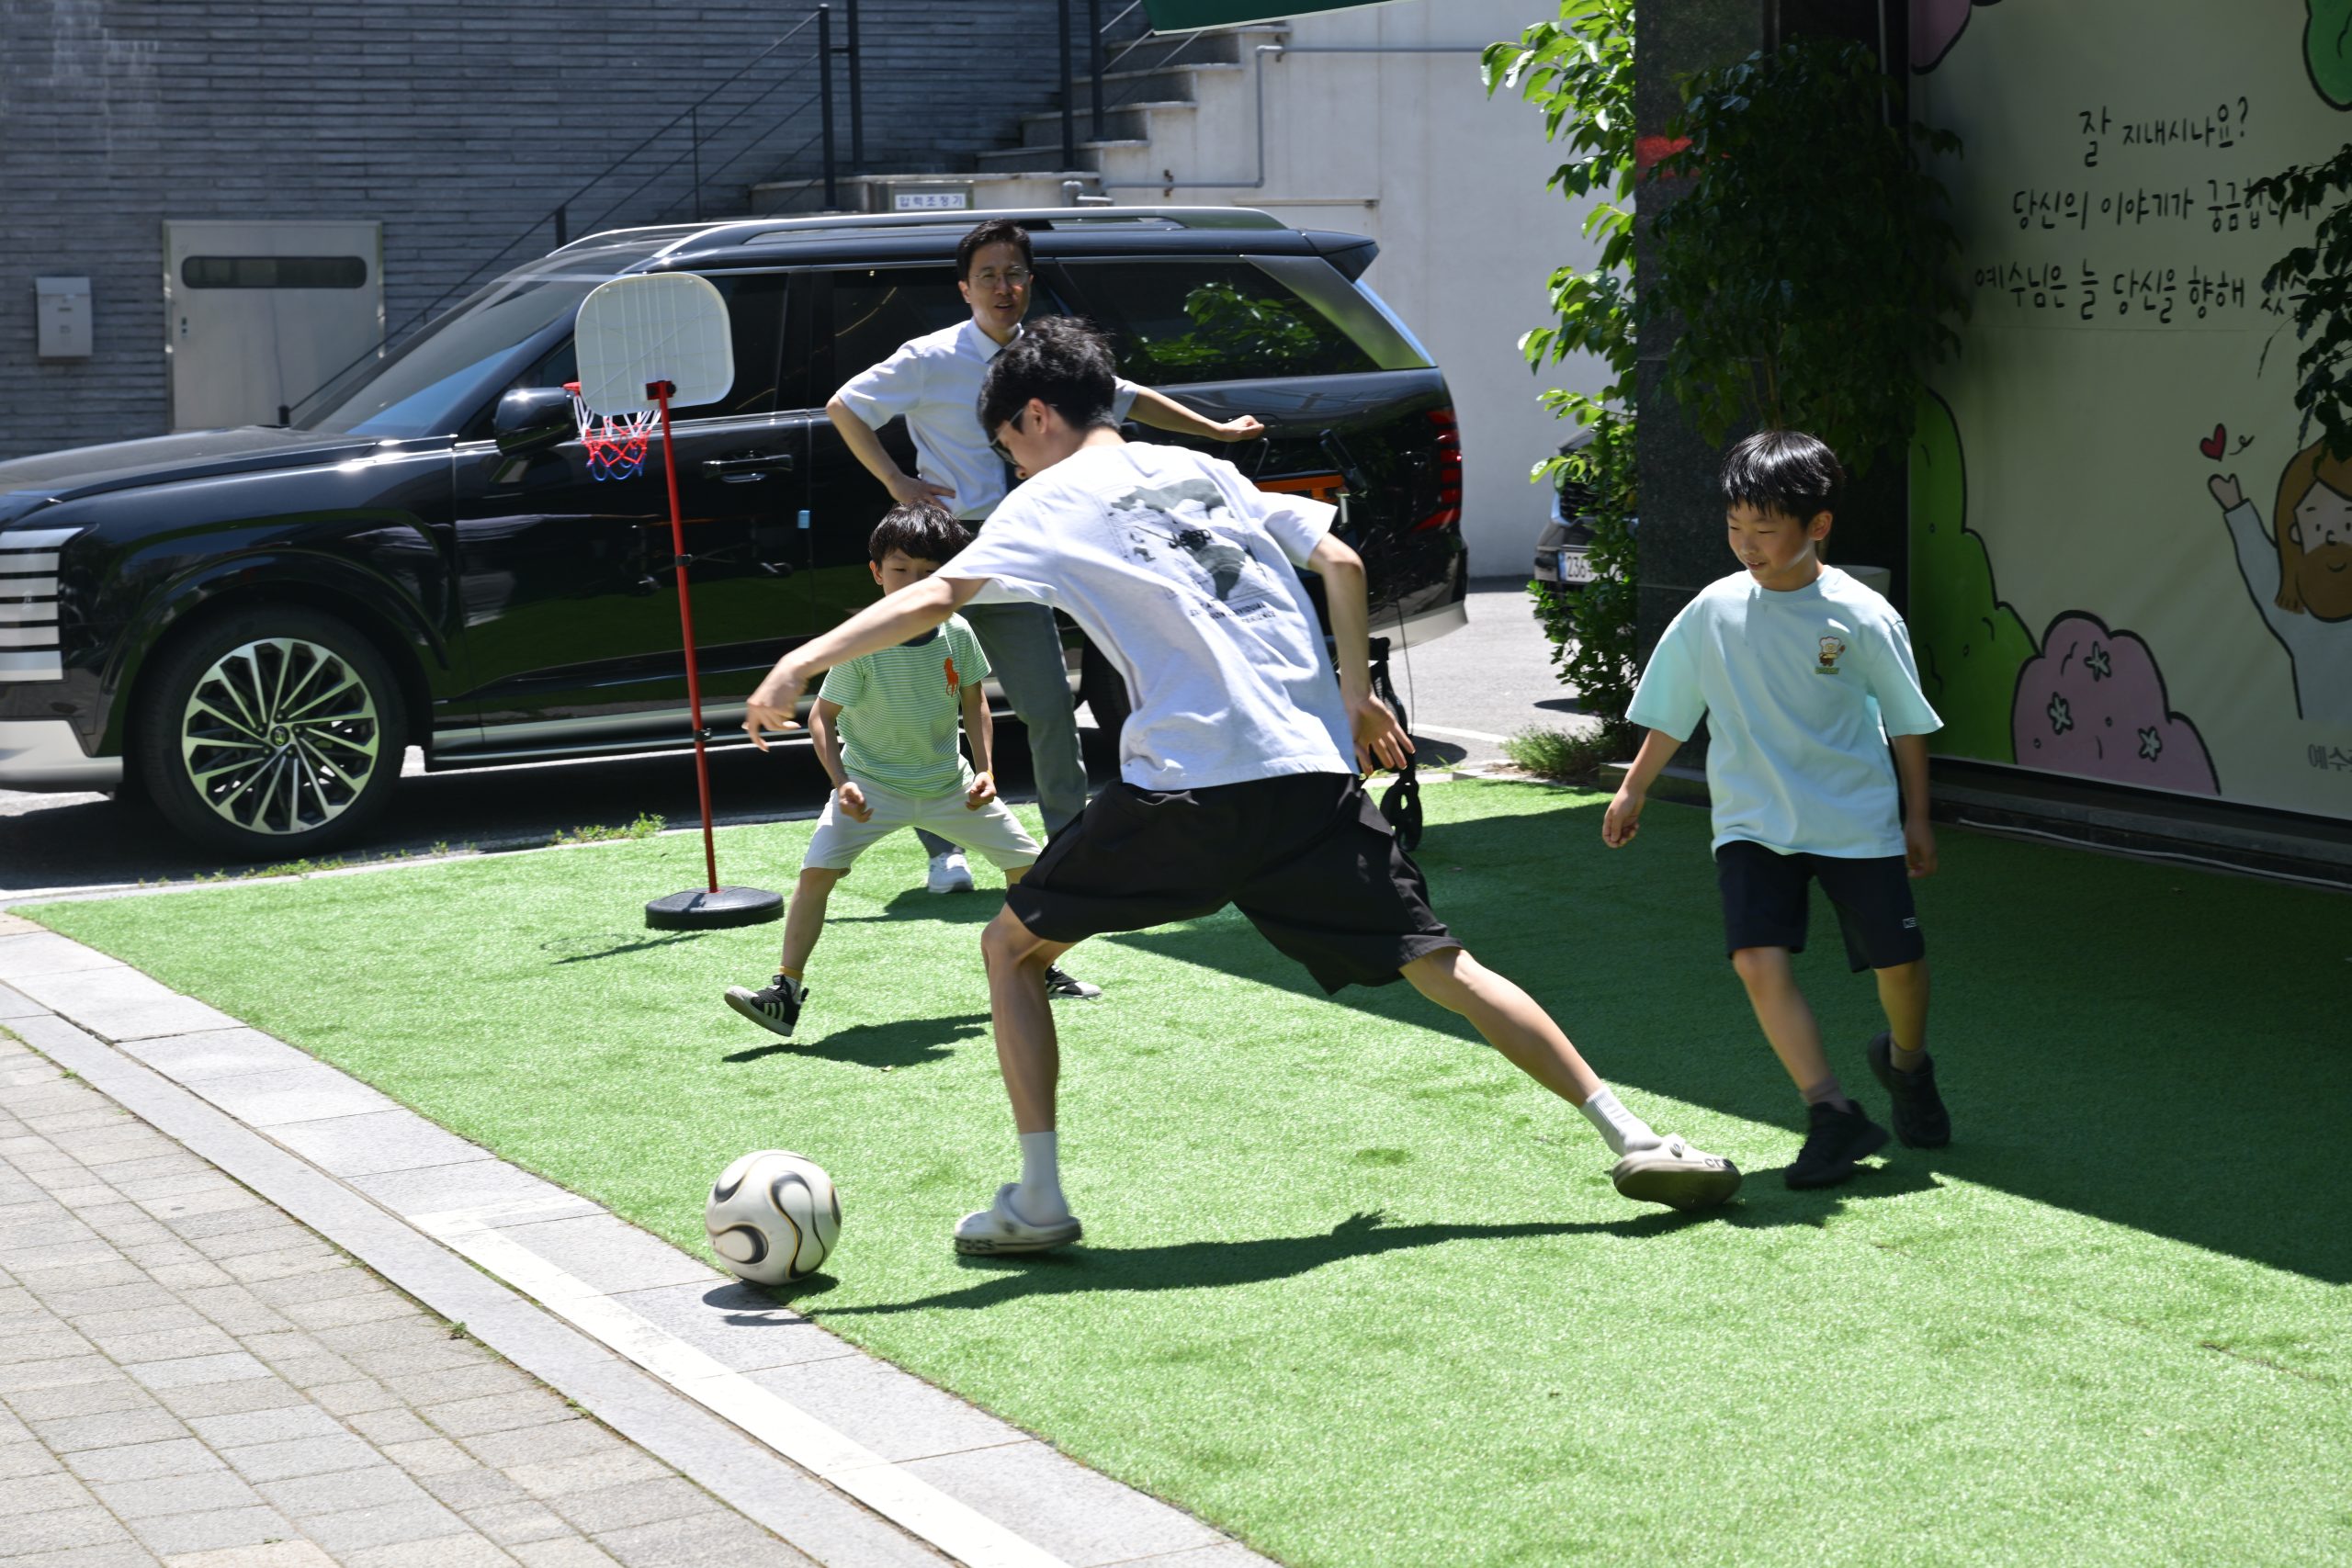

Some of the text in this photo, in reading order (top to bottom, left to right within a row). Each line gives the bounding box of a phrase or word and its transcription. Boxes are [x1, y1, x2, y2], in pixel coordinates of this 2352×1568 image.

[2079, 96, 2248, 167] 잘 지내시나요?
[2014, 189, 2088, 231] 당신의
[2101, 187, 2195, 225] 이야기가
[1975, 262, 2067, 309] 예수님은
[2081, 258, 2099, 321] 늘
[2114, 268, 2177, 323] 당신을
[2188, 265, 2245, 319] 향해
[2308, 744, 2352, 773] 예수
